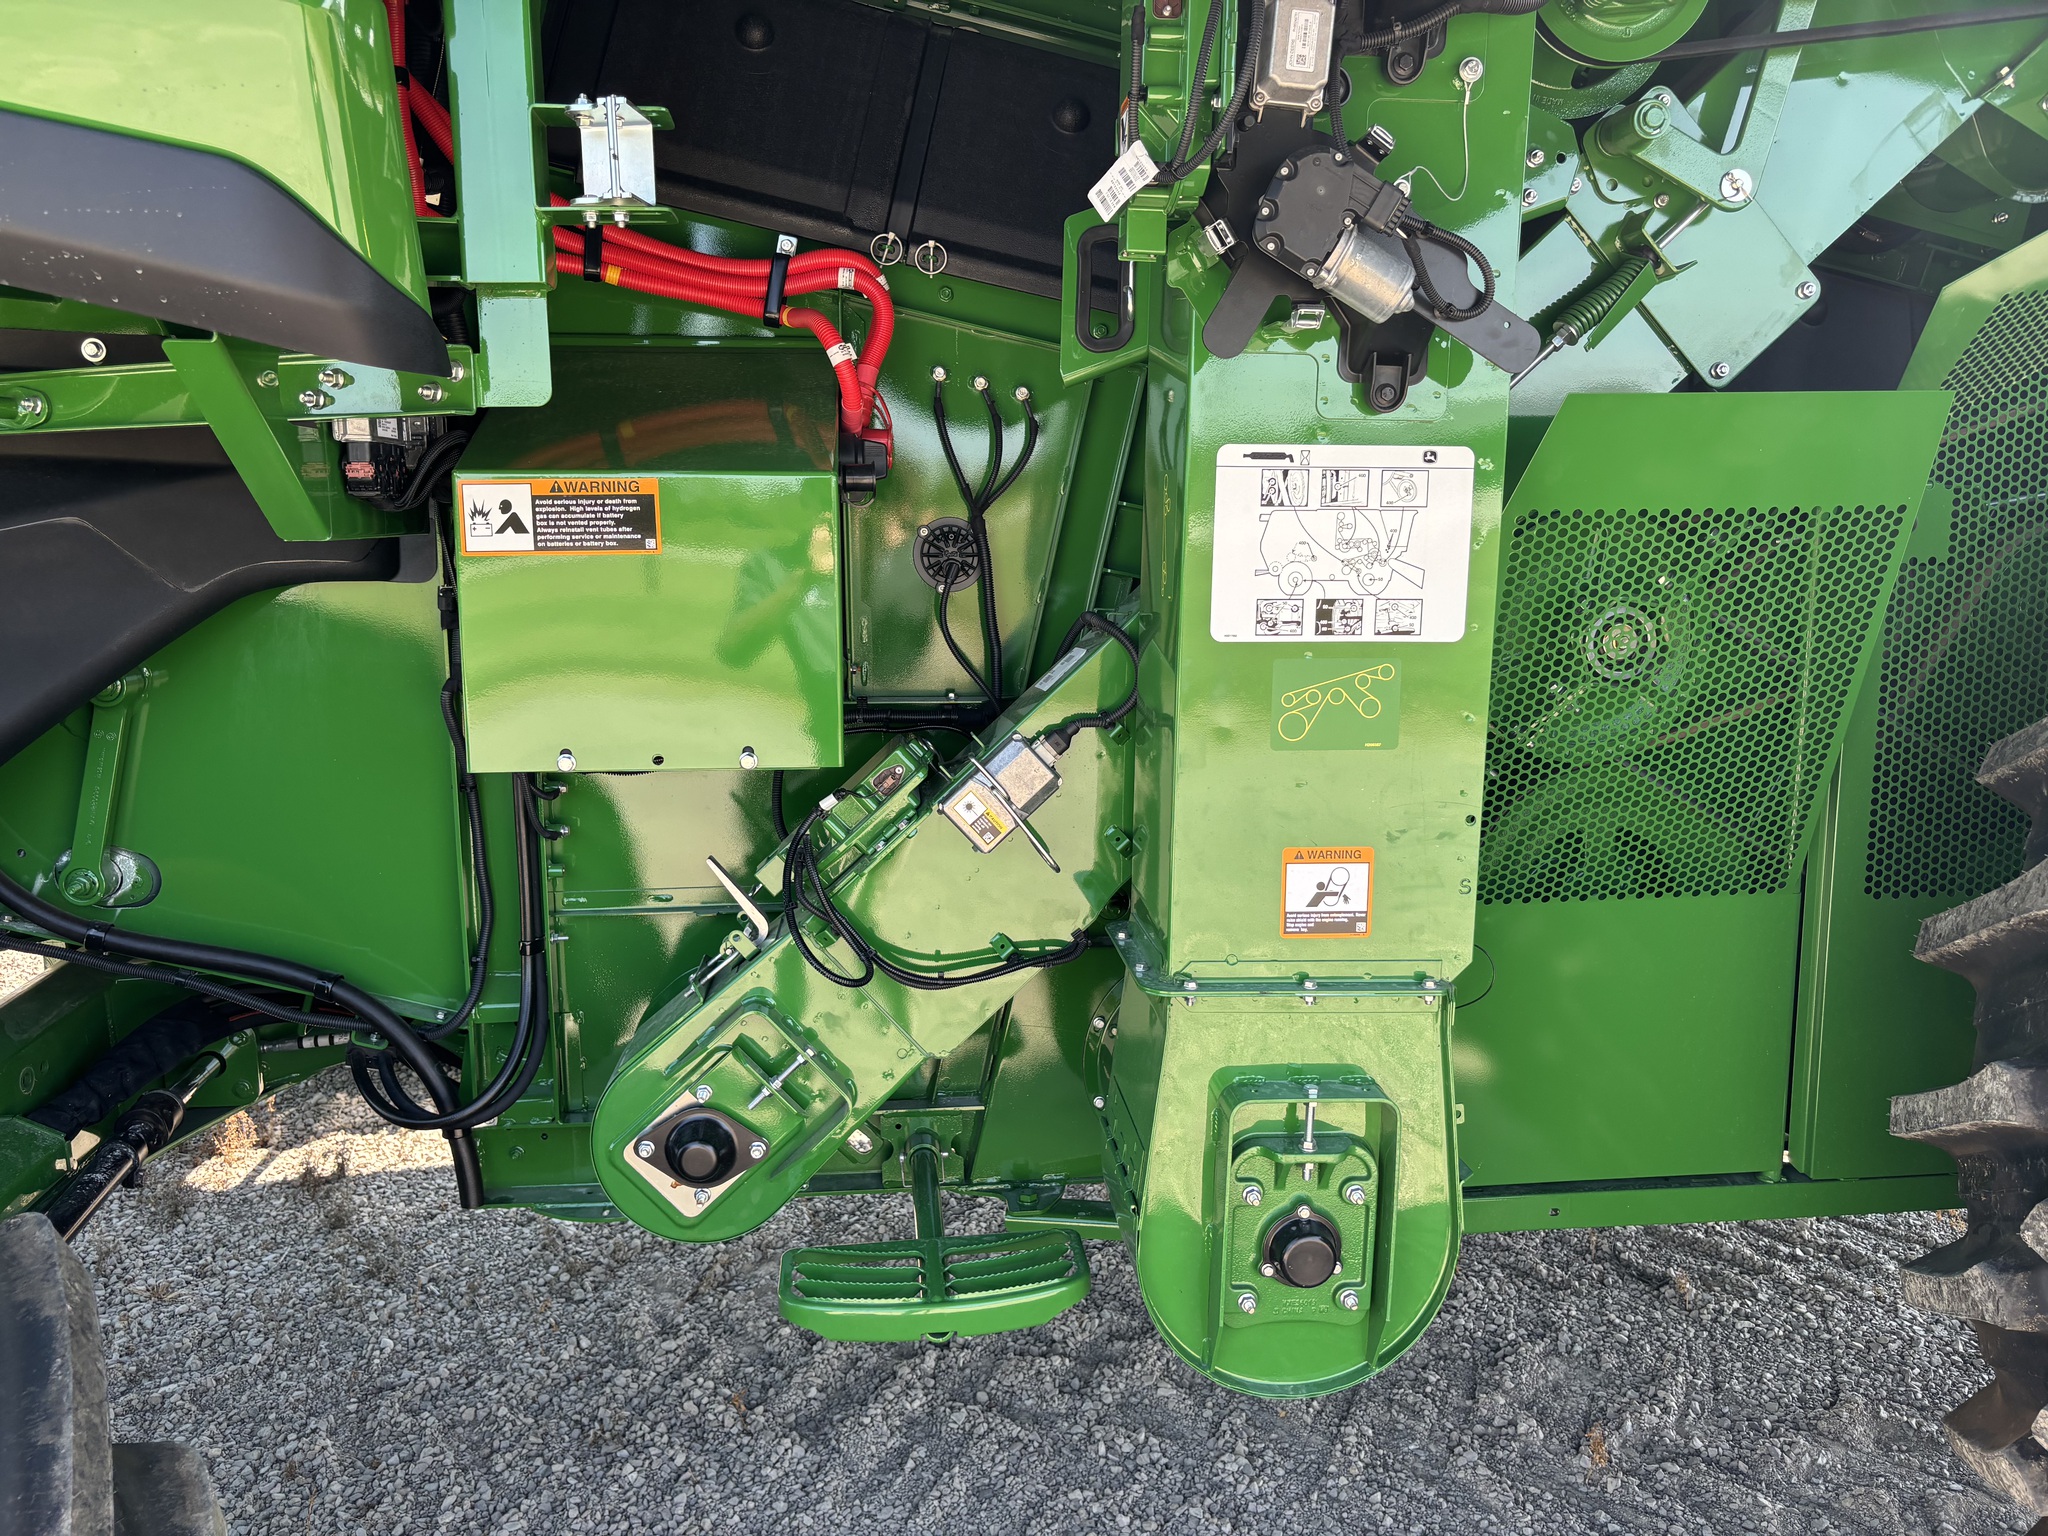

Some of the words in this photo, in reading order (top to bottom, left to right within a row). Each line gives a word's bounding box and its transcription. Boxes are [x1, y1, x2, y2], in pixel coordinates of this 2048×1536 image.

[564, 480, 640, 493] WARNING
[577, 498, 595, 506] injury
[569, 505, 584, 513] High
[612, 505, 641, 513] hydrogen
[602, 512, 624, 520] battery
[589, 520, 616, 528] properly.
[1307, 849, 1362, 859] WARNING
[1458, 877, 1472, 895] S
